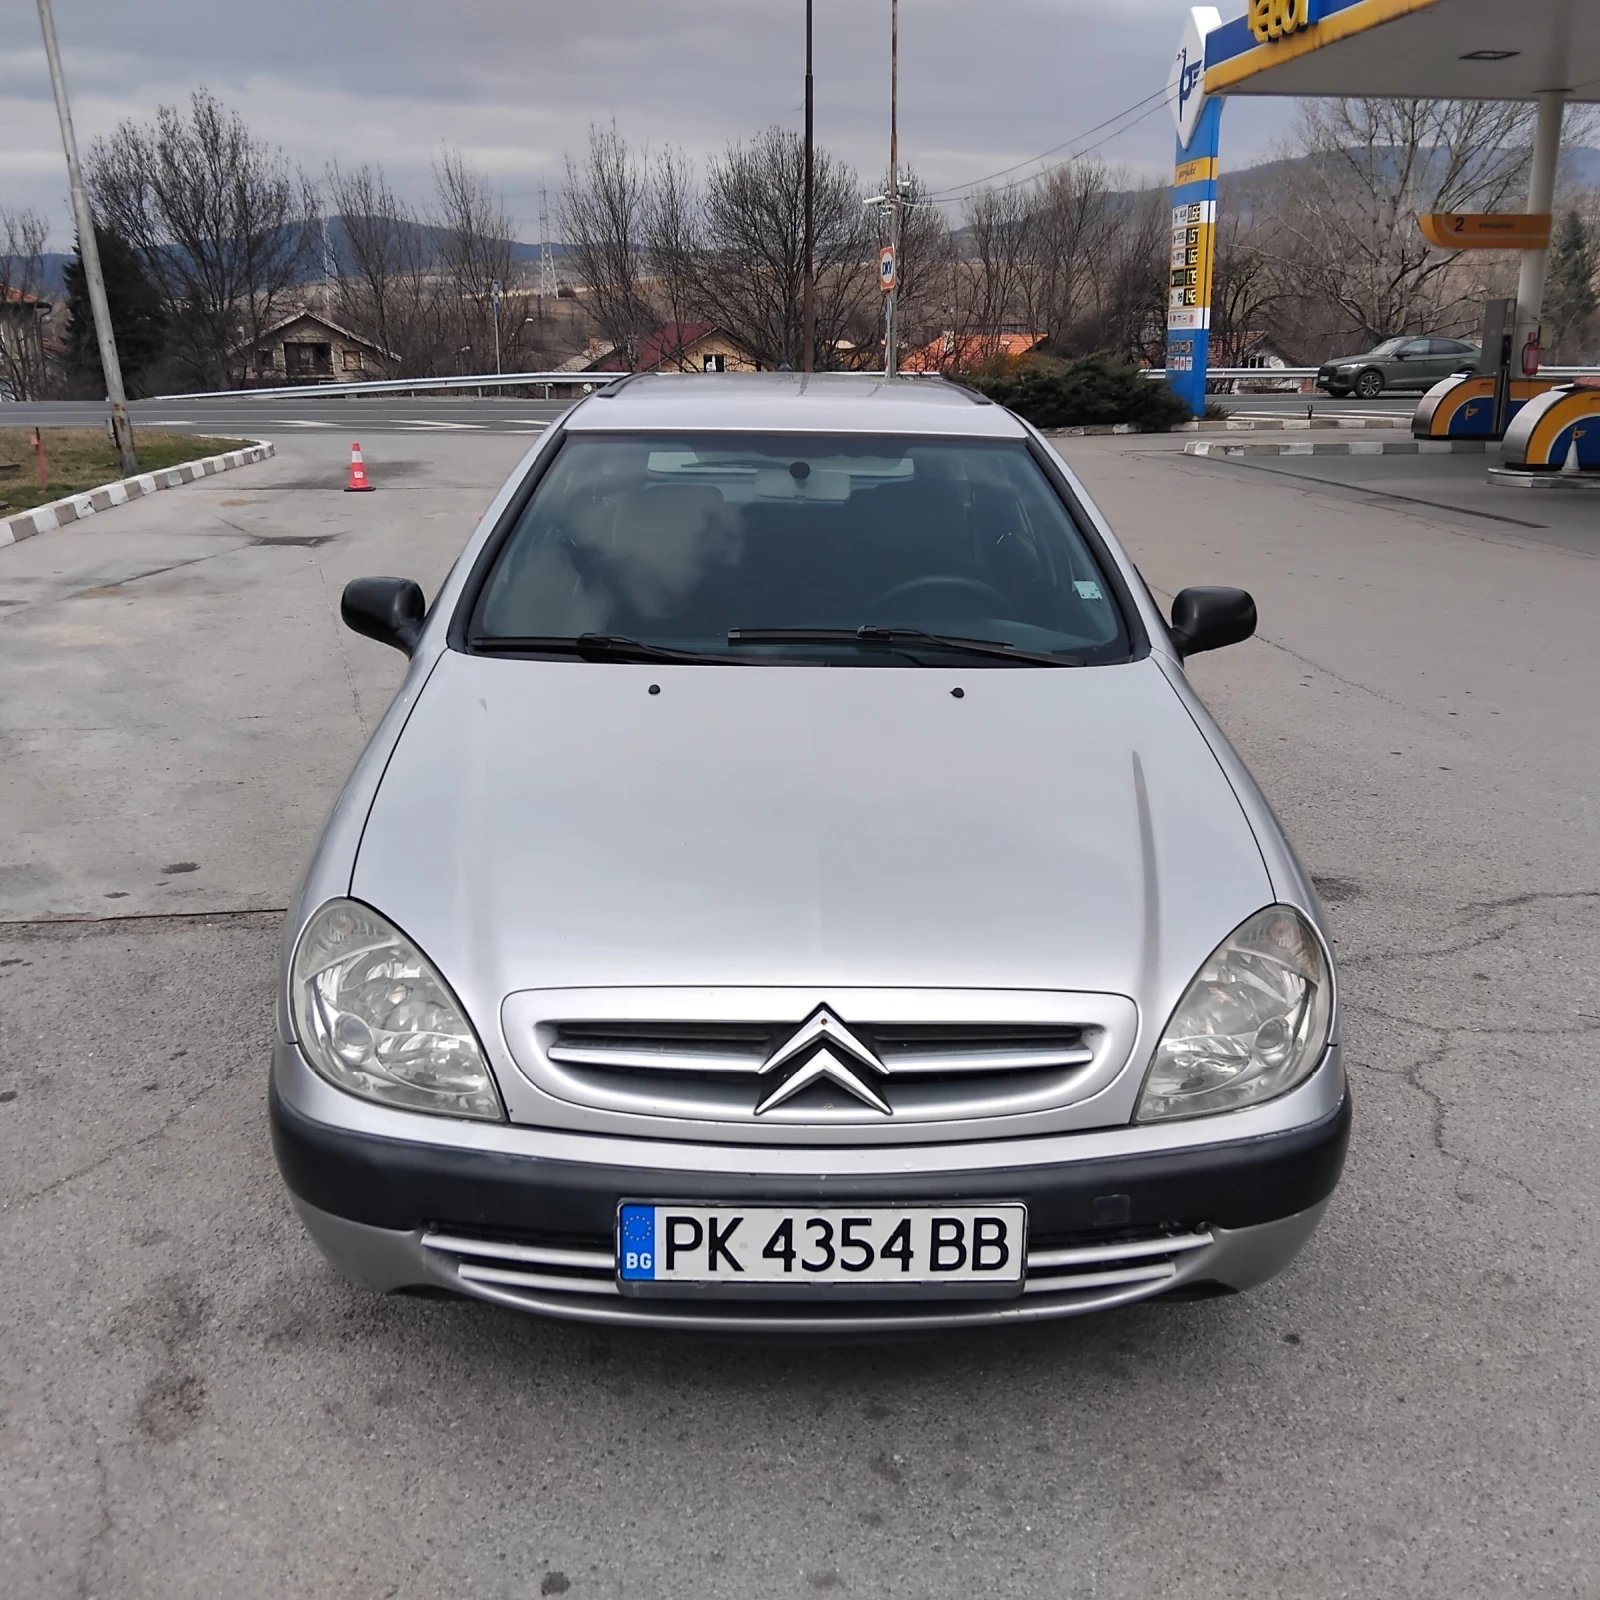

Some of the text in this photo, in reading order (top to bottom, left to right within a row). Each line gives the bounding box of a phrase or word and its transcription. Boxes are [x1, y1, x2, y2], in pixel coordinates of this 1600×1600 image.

[1454, 217, 1464, 231] 2
[882, 260, 892, 275] DKV
[665, 1215, 1010, 1273] PK 4354 BB
[626, 1253, 652, 1269] BG
